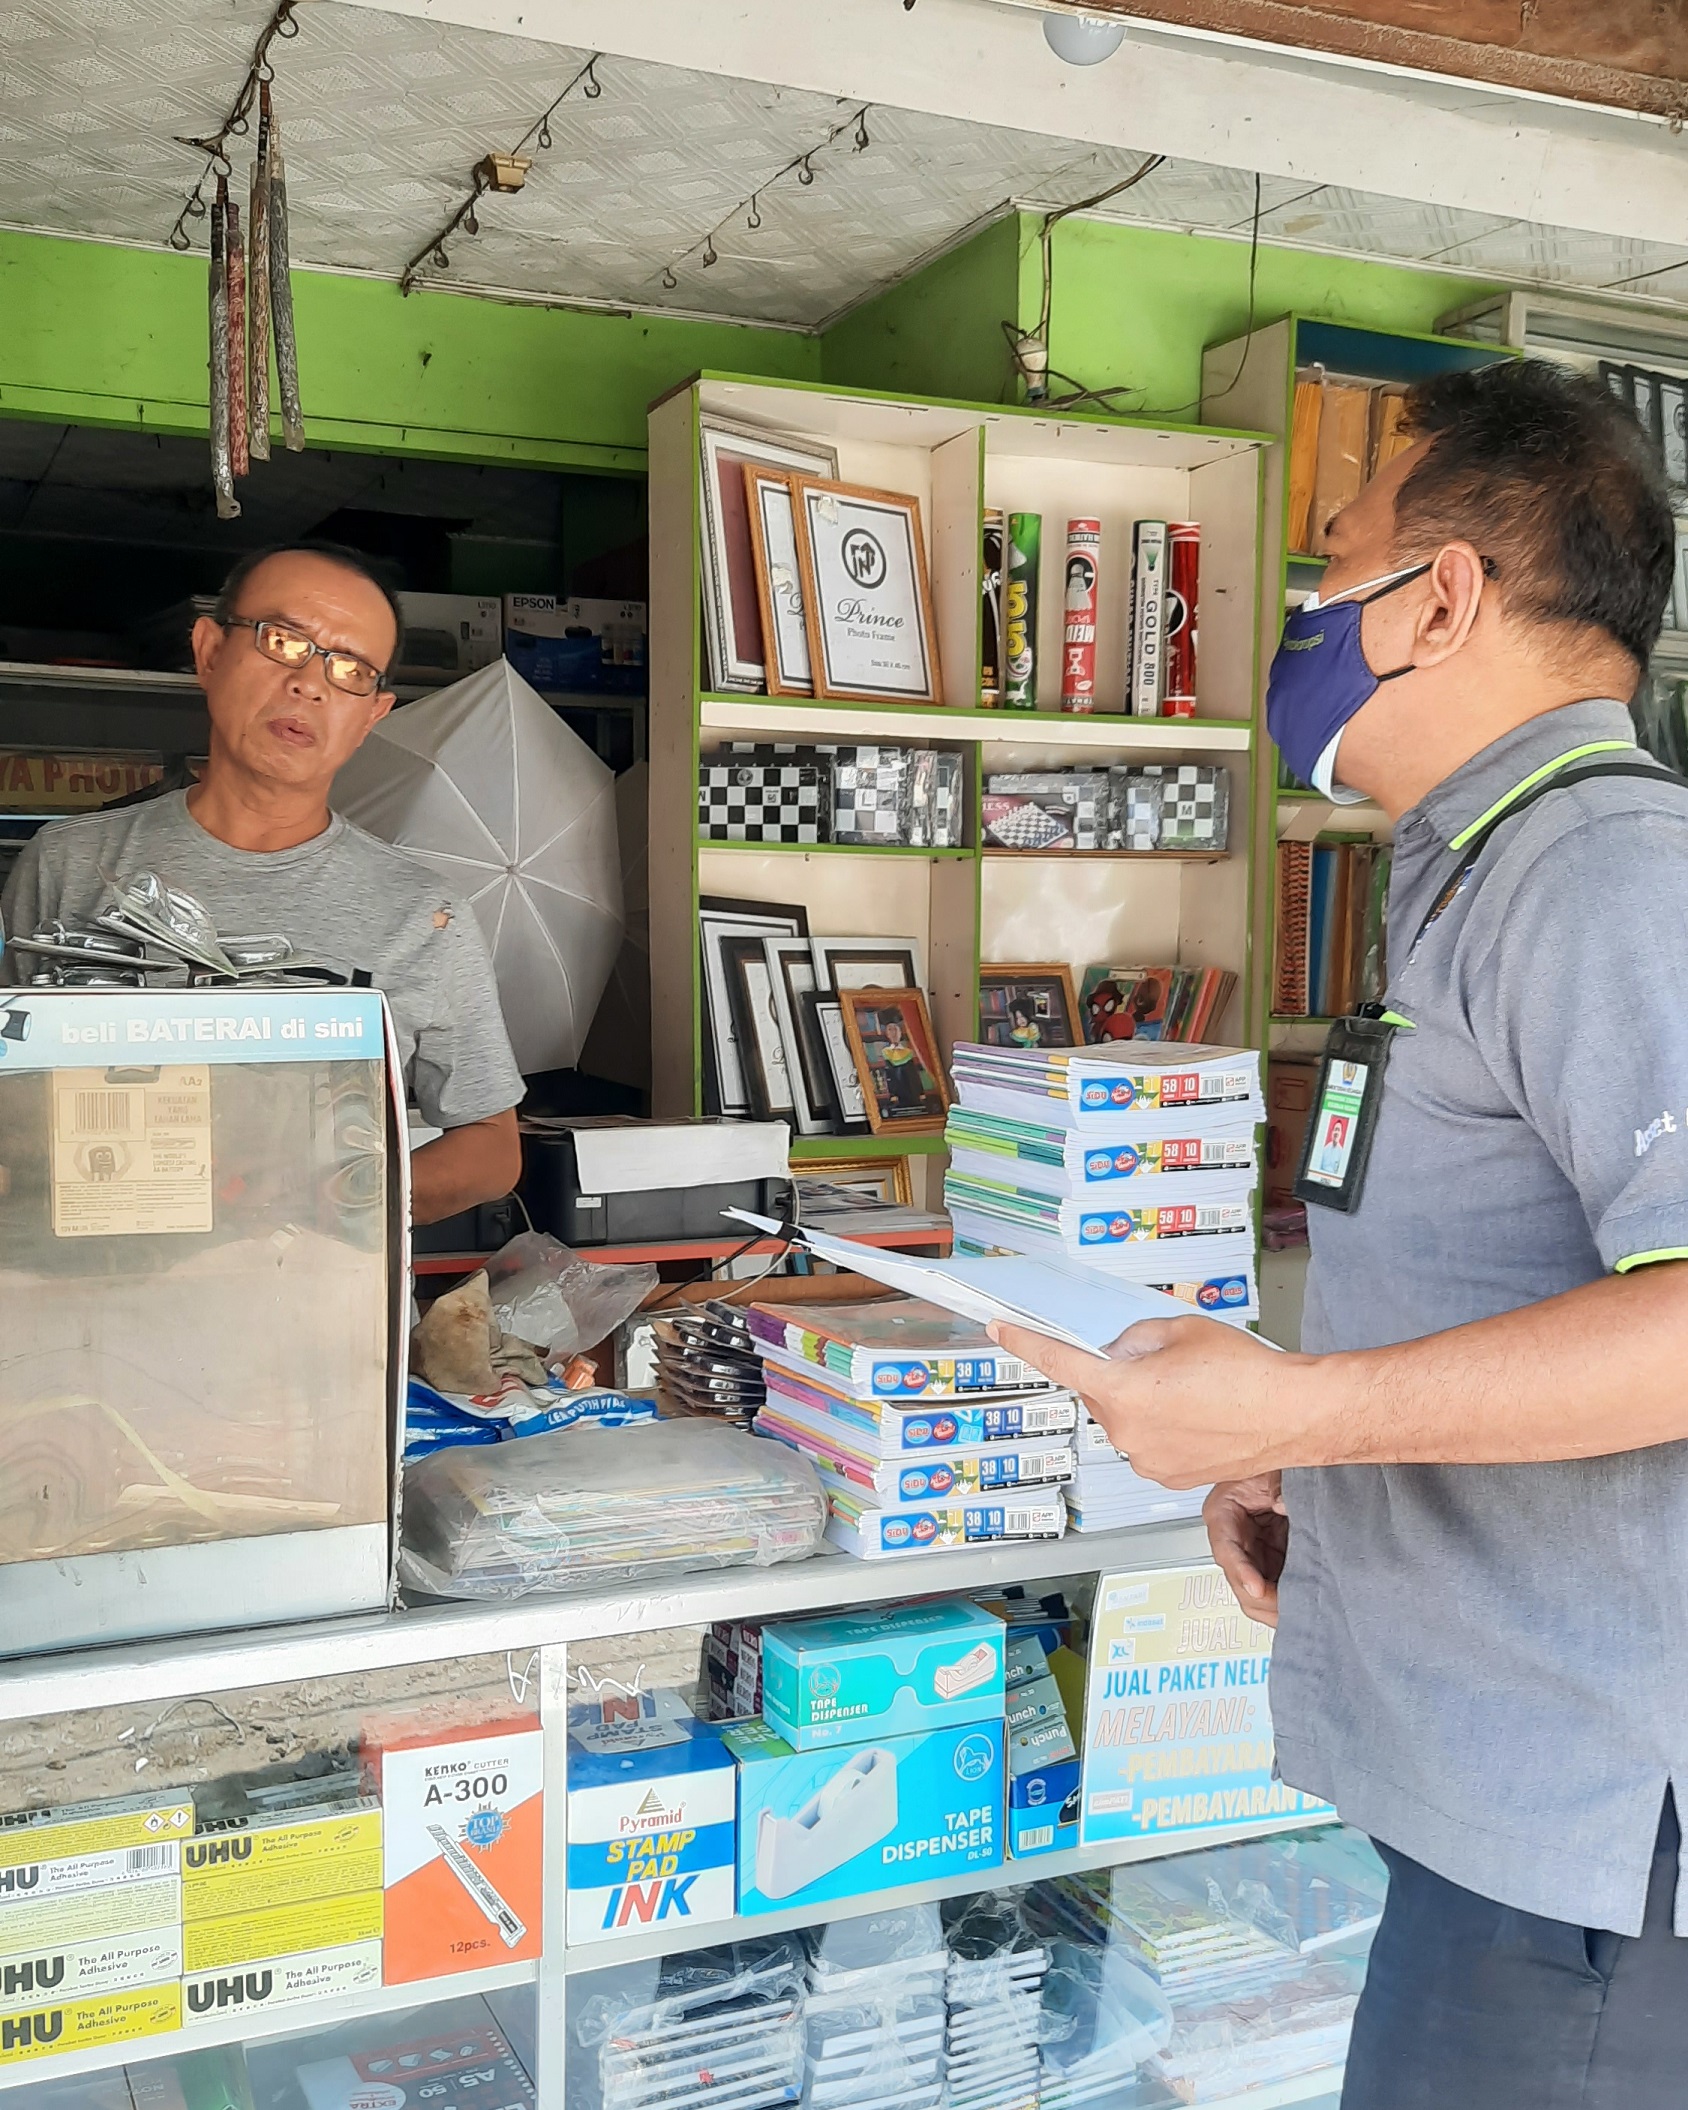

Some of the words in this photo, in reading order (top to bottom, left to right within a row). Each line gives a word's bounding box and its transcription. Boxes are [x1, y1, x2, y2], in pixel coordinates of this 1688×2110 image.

[513, 597, 554, 610] EPSON
[834, 598, 905, 629] Prince
[1144, 600, 1158, 655] GOLD
[1143, 662, 1155, 687] 800
[62, 1023, 117, 1045] beli
[126, 1016, 272, 1043] BATERAI
[280, 1018, 306, 1039] di
[315, 1016, 363, 1038] sini
[1162, 1078, 1178, 1093] 58
[1184, 1077, 1195, 1092] 10
[1164, 1143, 1178, 1157] 58
[1185, 1142, 1197, 1157] 10
[1159, 1210, 1174, 1225] 58
[1180, 1209, 1192, 1223] 10
[957, 1362, 972, 1378] 38
[979, 1361, 992, 1377] 10
[985, 1410, 1000, 1426] 38
[1006, 1408, 1019, 1424] 10
[982, 1459, 997, 1476] 38
[1003, 1457, 1015, 1473] 10
[967, 1511, 981, 1527] 38
[988, 1510, 1001, 1525] 10
[1178, 1573, 1238, 1611] JUA
[846, 1626, 877, 1636] TAPE
[879, 1614, 945, 1632] DISPENSER
[1176, 1616, 1243, 1654] JUAL
[1005, 1665, 1024, 1681] nch
[1103, 1669, 1152, 1699] JUAL
[1158, 1662, 1220, 1693] PAKET
[810, 1697, 837, 1711] TAPE
[811, 1704, 869, 1721] DISPENSER
[1007, 1705, 1036, 1724] unch
[1093, 1696, 1256, 1749] MELAYANI:
[586, 1724, 664, 1740] STAMP
[811, 1727, 832, 1738] No.
[836, 1725, 842, 1735] 7
[1031, 1725, 1068, 1747] Punch
[424, 1762, 468, 1777] KENKO
[474, 1758, 510, 1769] CUTTER
[1118, 1741, 1274, 1784] -PEMBAYARA
[424, 1773, 509, 1807] A-300
[0, 1810, 52, 1827] HU
[471, 1815, 500, 1829] TOP
[619, 1807, 683, 1834] Pyramid
[944, 1805, 993, 1832] TAPE
[262, 1837, 276, 1845] The
[278, 1833, 289, 1843] All
[290, 1829, 322, 1841] Purpose
[882, 1826, 993, 1865] DISPENSER
[186, 1836, 252, 1868] UHU
[262, 1841, 298, 1853] Adhesive
[606, 1830, 696, 1863] STAMP
[967, 1846, 993, 1861] DL-50
[50, 1866, 64, 1874] The
[67, 1862, 79, 1873] All
[80, 1857, 115, 1871] Purpose
[626, 1856, 678, 1882] PAD
[50, 1869, 90, 1882] Adhesive
[601, 1874, 701, 1930] INK
[450, 1938, 491, 1954] 12pcs.
[79, 1957, 97, 1967] The
[100, 1952, 115, 1964] All
[117, 1944, 161, 1961] Purpose
[0, 1955, 65, 1995] HU
[79, 1961, 128, 1978] Adhesive
[285, 1970, 303, 1980] The
[305, 1965, 319, 1976] All
[321, 1959, 362, 1974] Purpose
[187, 1969, 273, 2013] UHU
[285, 1975, 331, 1990] Adhesive
[77, 2011, 96, 2021] The
[99, 2006, 113, 2018] All
[115, 1998, 159, 2015] Purpose
[77, 2015, 127, 2032] Adhesive
[459, 2068, 497, 2088] A5
[419, 2084, 448, 2099] 50
[349, 2098, 397, 2110] EXTRA
